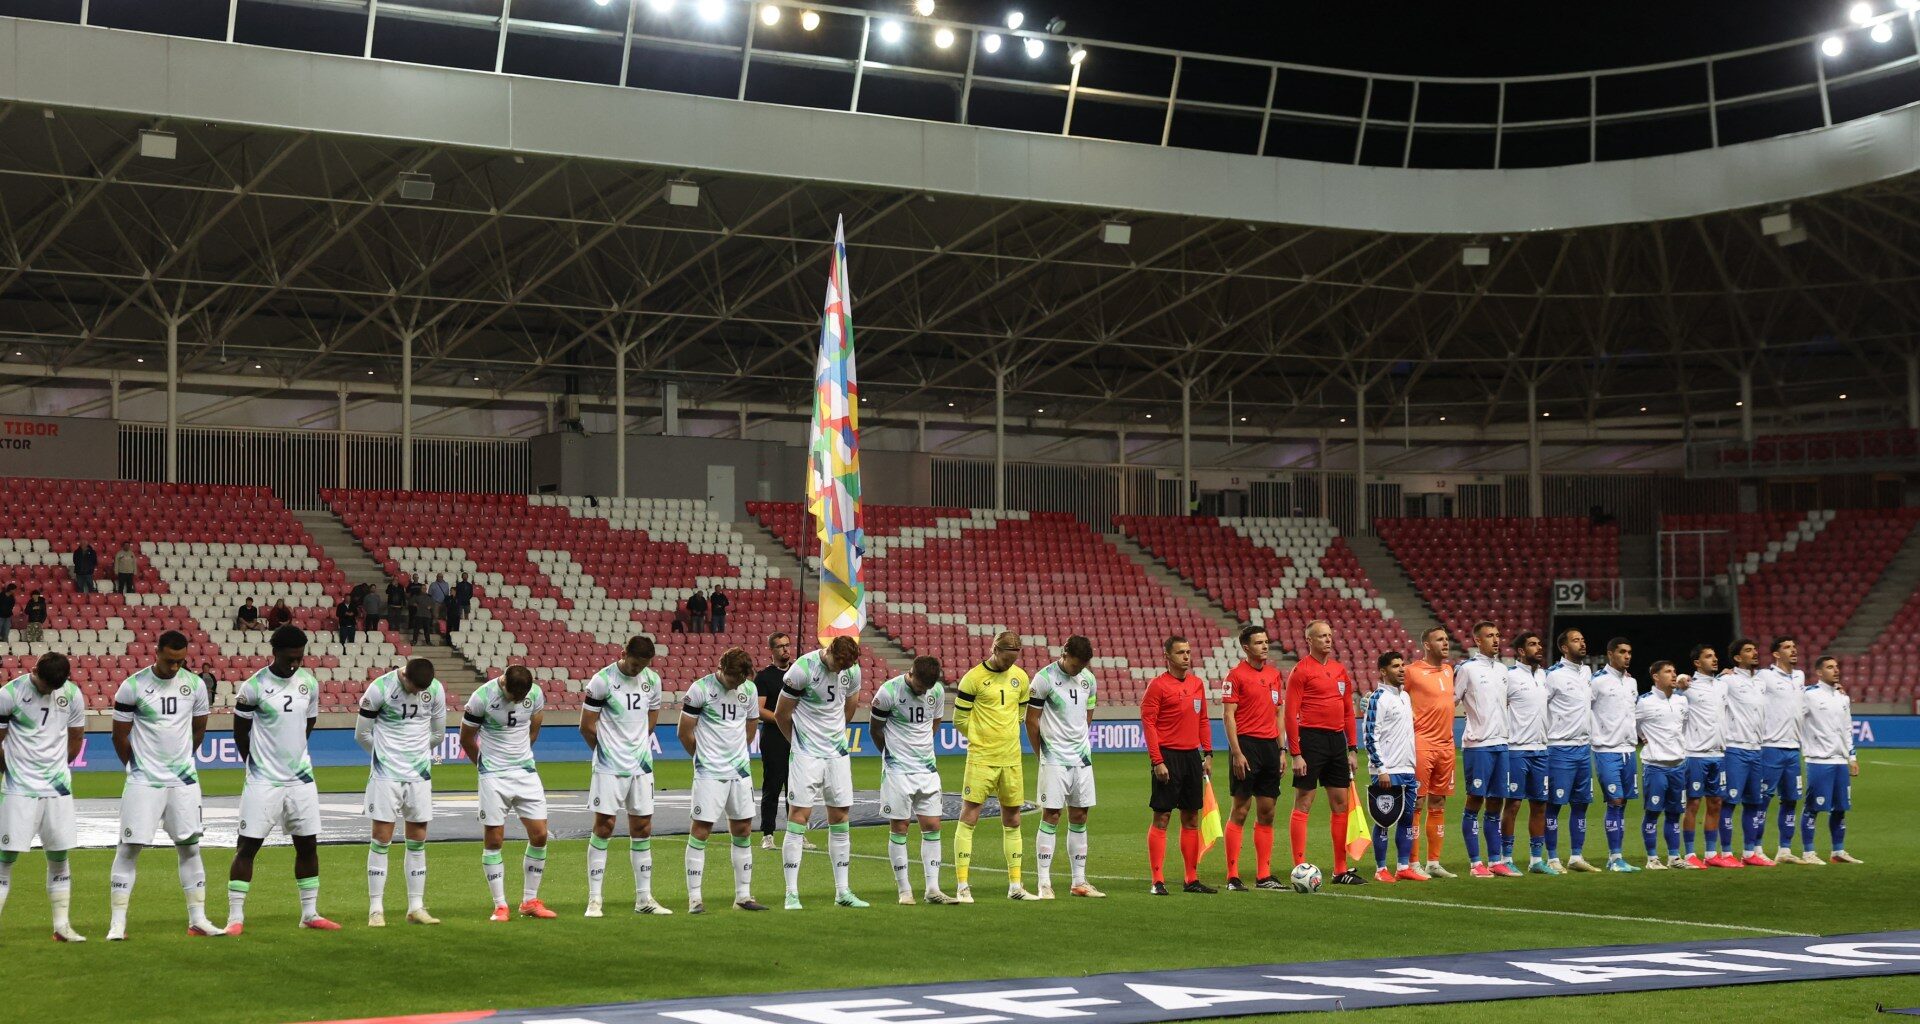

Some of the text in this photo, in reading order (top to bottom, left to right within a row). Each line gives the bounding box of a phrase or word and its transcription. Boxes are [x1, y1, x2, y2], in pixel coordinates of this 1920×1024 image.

[4, 421, 59, 436] TIBOR
[1556, 583, 1583, 600] B9
[1438, 677, 1446, 691] 1
[626, 693, 641, 710] 12
[826, 685, 836, 702] 5
[999, 689, 1005, 705] 1
[1069, 688, 1078, 705] 4
[161, 696, 177, 715] 10
[283, 695, 293, 712] 2
[721, 703, 736, 720] 14
[40, 707, 50, 726] 7
[507, 710, 517, 727] 6
[909, 706, 924, 723] 18
[1088, 724, 1146, 749] #FOOTBA
[522, 982, 1347, 1024] EFA
